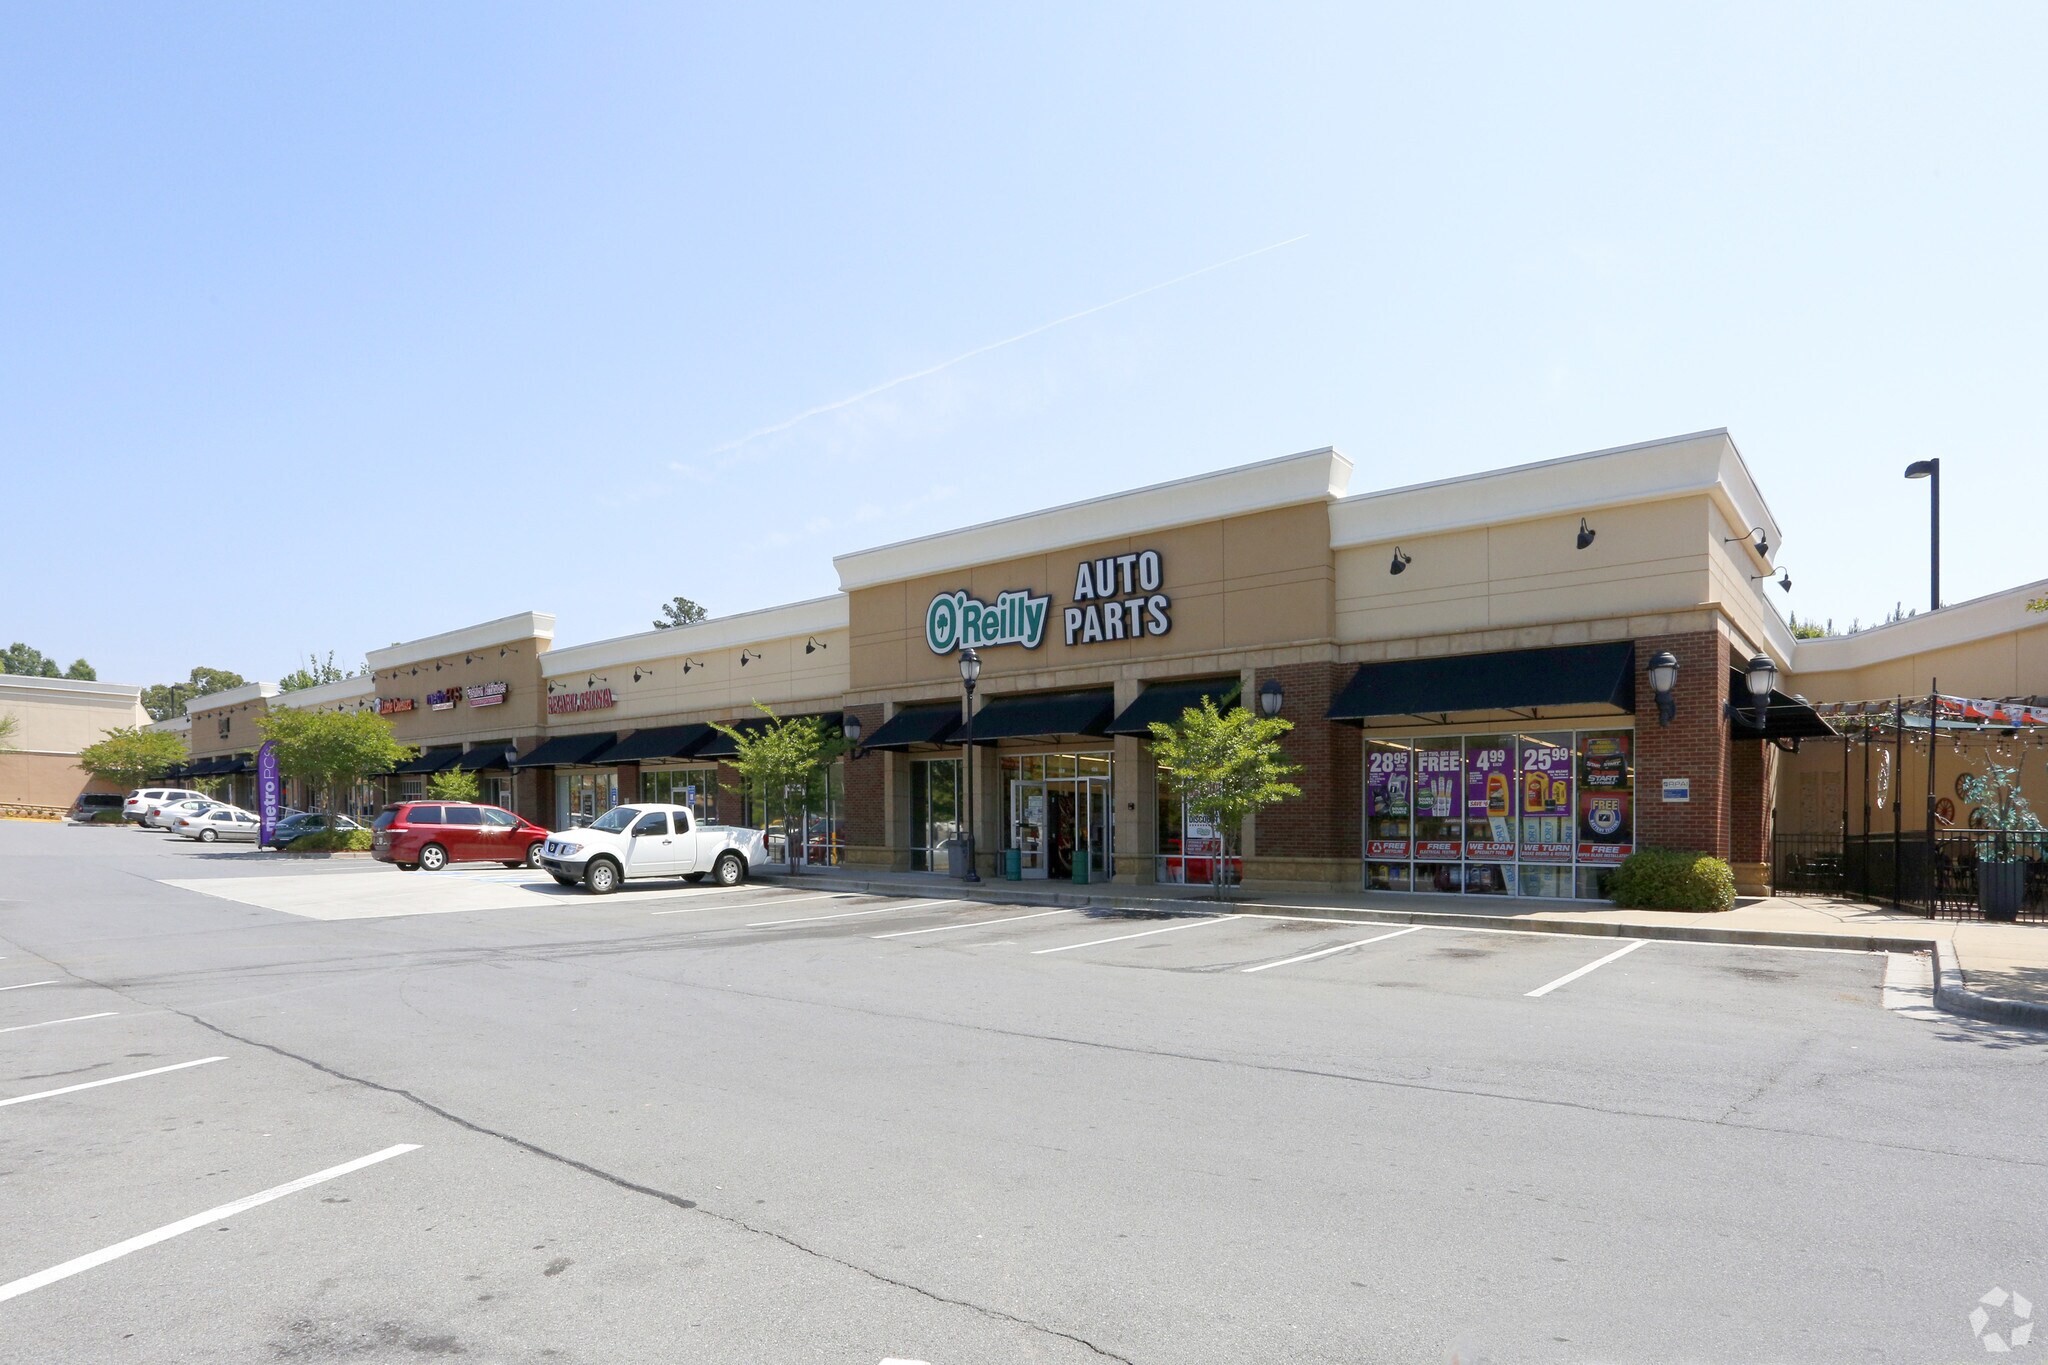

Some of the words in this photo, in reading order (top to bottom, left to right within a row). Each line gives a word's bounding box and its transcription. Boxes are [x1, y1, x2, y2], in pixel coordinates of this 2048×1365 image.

[1074, 550, 1161, 600] AUTO
[928, 592, 1047, 651] O'Reilly
[1065, 594, 1170, 645] PARTS
[1418, 757, 1460, 772] FREE
[1592, 800, 1618, 810] FREE
